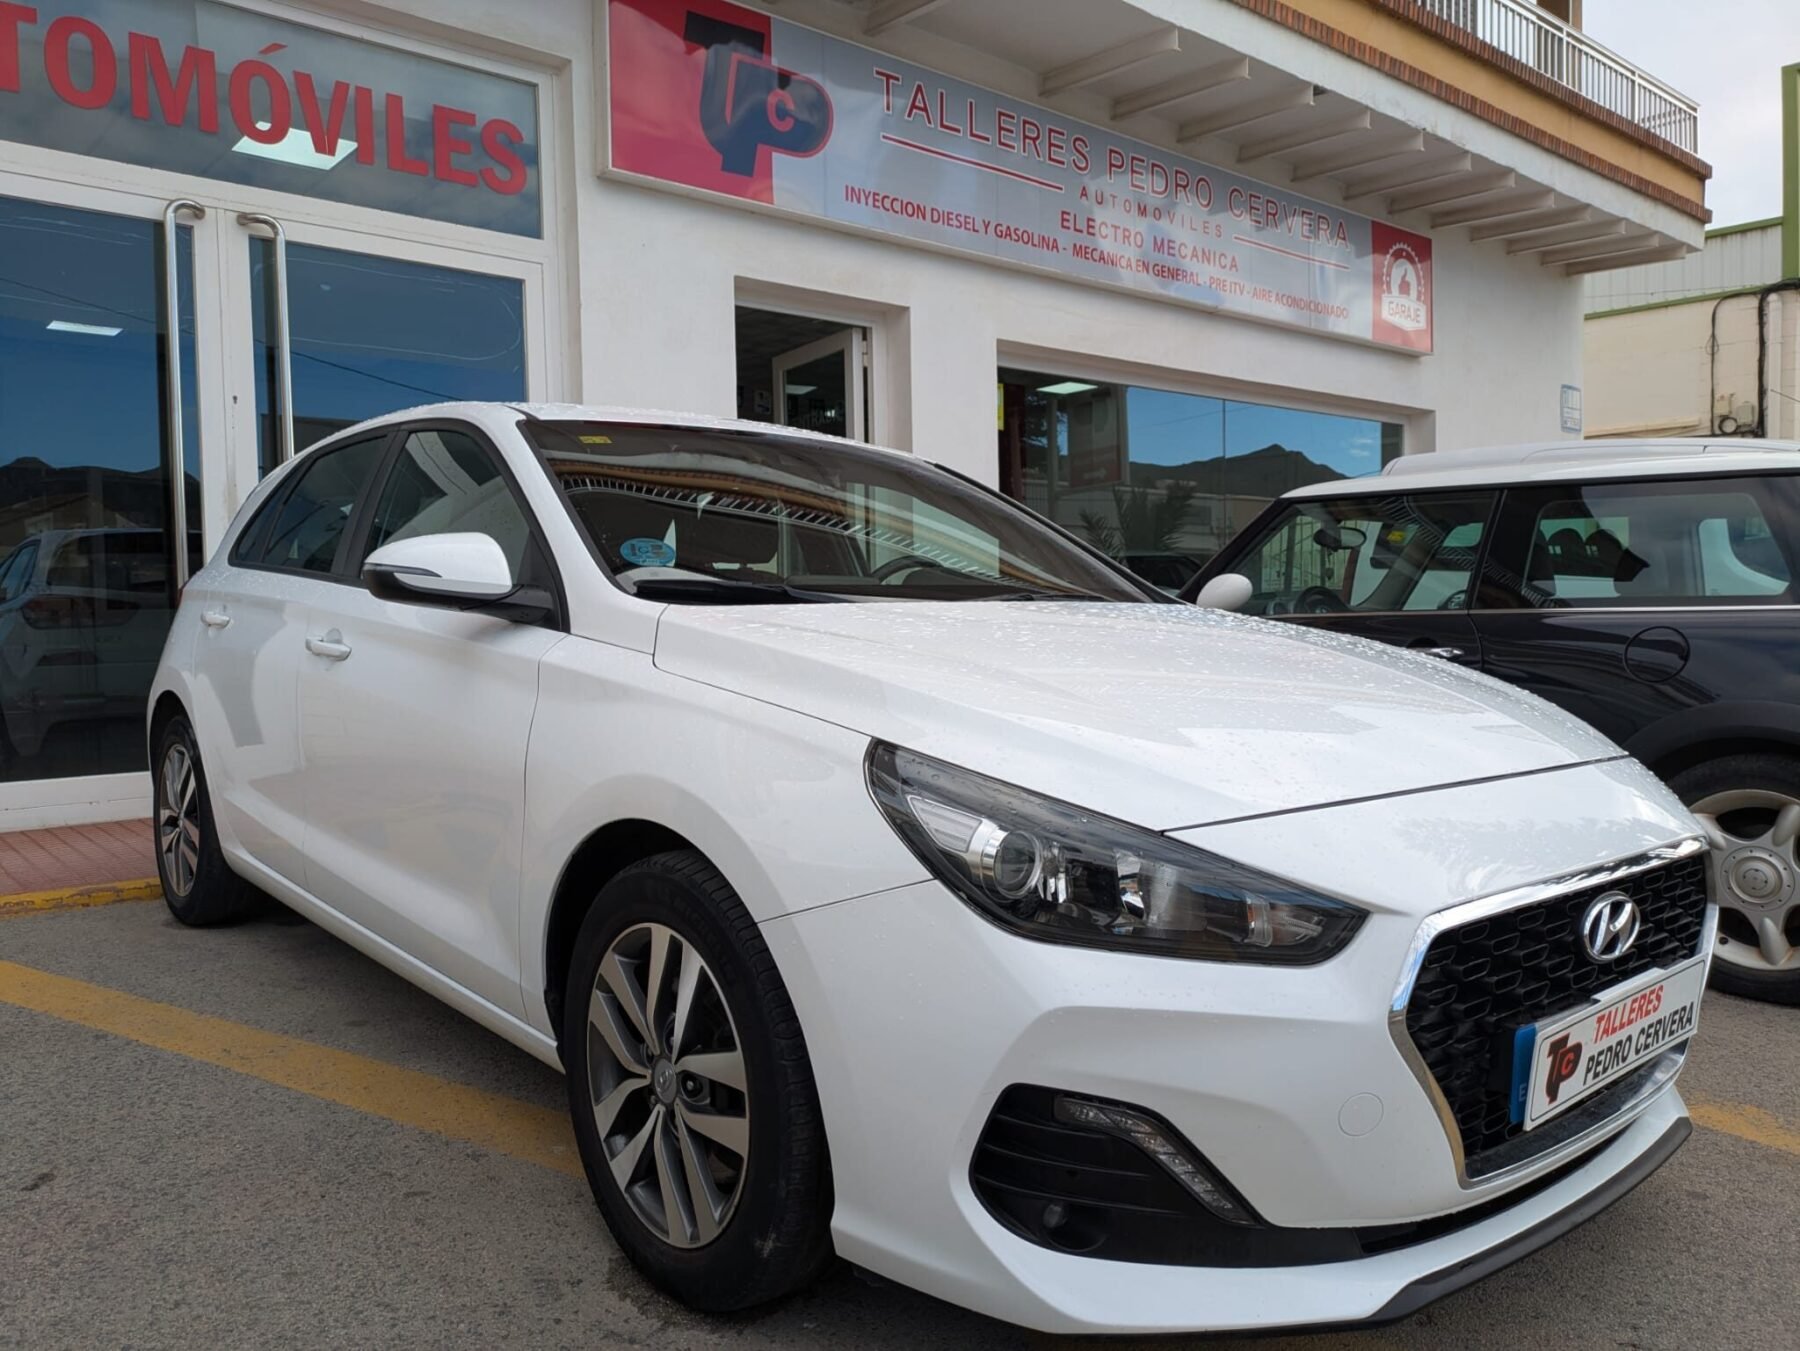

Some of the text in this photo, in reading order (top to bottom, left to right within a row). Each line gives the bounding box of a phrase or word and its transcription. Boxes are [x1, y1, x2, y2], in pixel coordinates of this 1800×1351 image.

[874, 66, 1350, 249] TALLERES PEDRO CERVERA
[1060, 210, 1239, 272] ELECTRO MECANICA
[1079, 185, 1223, 238] AUTOMOVILES
[845, 184, 927, 221] INYECCION
[930, 207, 979, 233] DIESEL
[982, 219, 992, 235] Y
[994, 223, 1060, 253] GASOLINA
[1072, 243, 1133, 272] MECANICA
[1136, 258, 1150, 275] EN
[1152, 262, 1202, 286] GENERAL
[1252, 286, 1273, 303] AIRE
[1275, 291, 1350, 319] ACONDICIONADO
[1387, 300, 1421, 323] GARAJE
[1583, 1001, 1695, 1087] PEDRO CERVERA
[1593, 984, 1664, 1044] TALLERES
